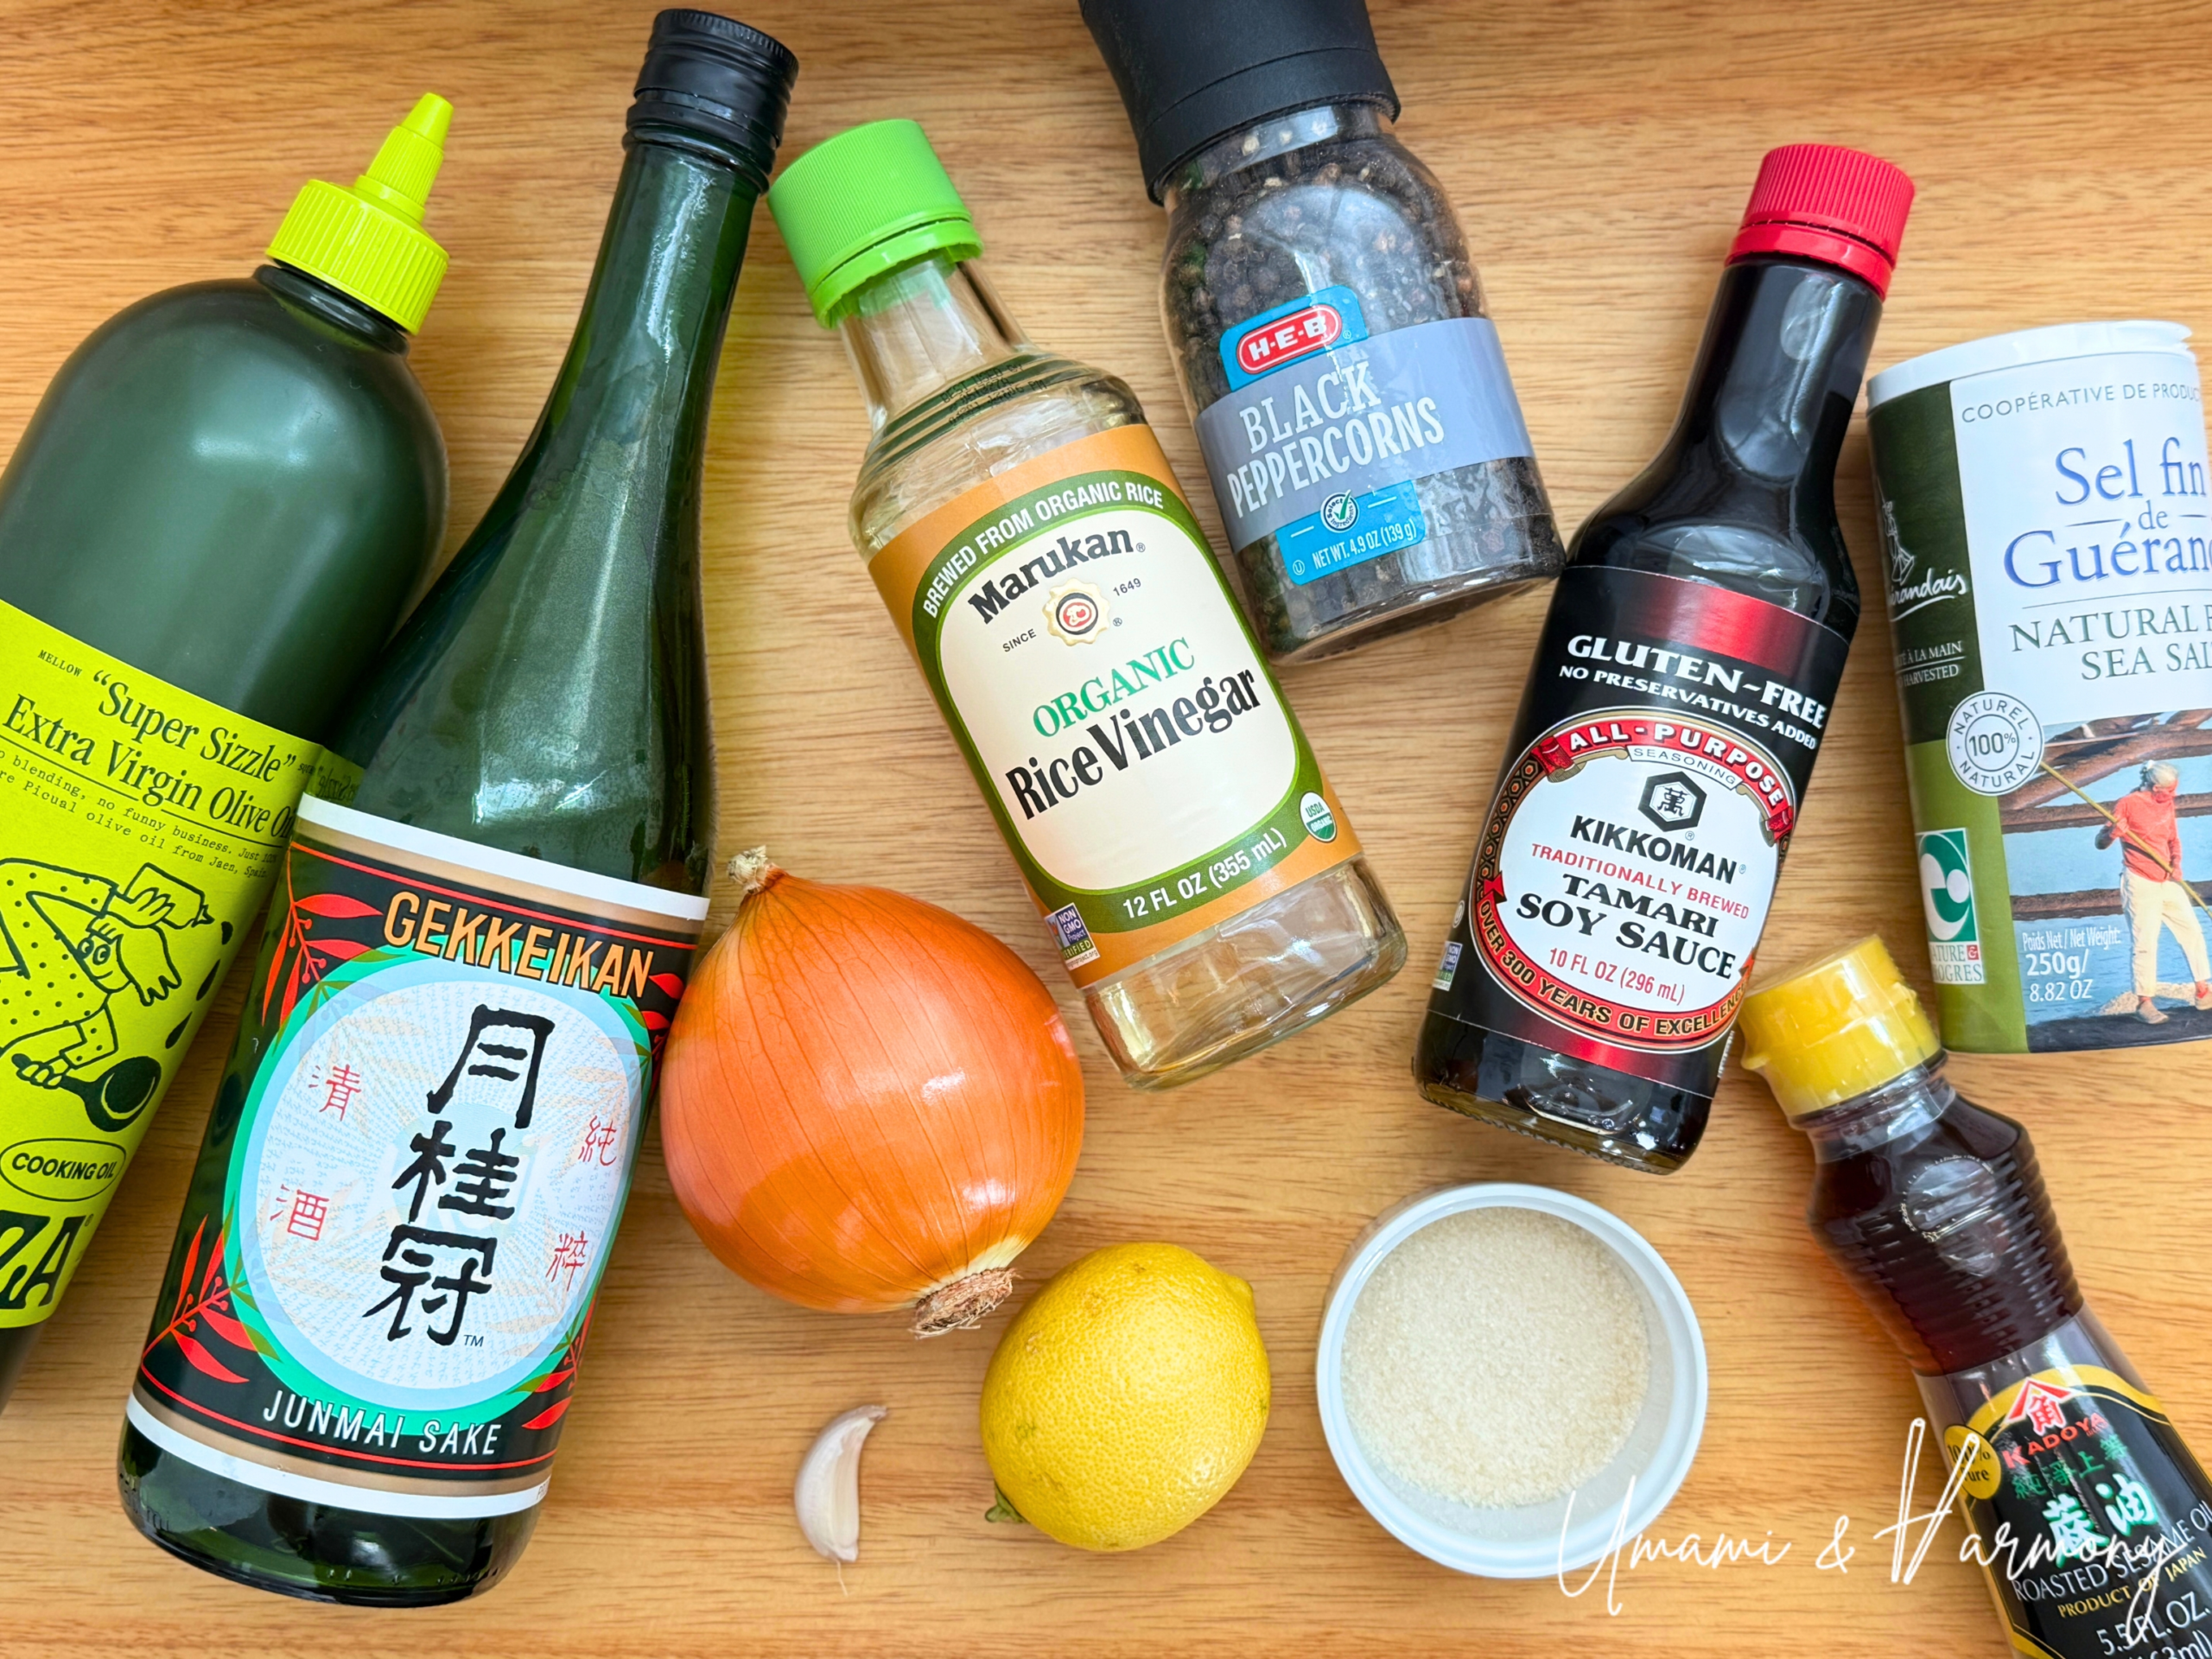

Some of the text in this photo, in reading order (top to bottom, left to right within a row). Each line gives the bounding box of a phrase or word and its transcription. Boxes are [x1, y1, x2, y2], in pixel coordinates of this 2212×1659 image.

[1247, 314, 1327, 362] H-E-B
[1239, 360, 1382, 454] BLACK
[1961, 385, 2114, 423] COOPÉRATIVE
[2123, 384, 2146, 399] DE
[1227, 396, 1445, 518] PEPPERCORNS
[2055, 436, 2207, 506] Sel fin
[2138, 499, 2169, 531] de
[923, 481, 1165, 618] BREWED FROM ORGANIC RICE
[1312, 518, 1417, 570] NET WT. 4.9 OZ (139 g)
[967, 528, 1135, 625] Marukan
[1113, 577, 1142, 597] 1649
[1002, 628, 1037, 653] SINCE
[1914, 648, 1927, 663] LA
[1929, 640, 1962, 659] MAIN
[2008, 604, 2199, 652] NATURAL
[37, 649, 83, 677] MELLOW
[1567, 634, 1827, 730] GLUTEN-FREE
[1904, 664, 1960, 687] HARVESTED
[2081, 641, 2212, 681] SEA SAL
[1033, 637, 1196, 738] ORGANIC
[1559, 664, 1818, 751] NO PRESERVATIVES ADDED
[1954, 698, 2026, 735] NATUREL
[3, 693, 96, 766] Extra
[107, 740, 204, 811] Virgin
[209, 787, 270, 833] Olive
[1005, 668, 1262, 821] Rice Vinegar
[1568, 722, 1783, 807] ALL-PURPOSE
[1633, 747, 1737, 787] SEASONING
[1959, 750, 2036, 789] NATURAL
[1968, 732, 2017, 757] 100%
[13, 755, 86, 800] blending,
[97, 798, 116, 810] no
[124, 808, 166, 831] funny
[172, 826, 232, 854] business.
[238, 848, 260, 861] Just
[22, 780, 77, 813] Picual
[86, 812, 131, 836] olive
[140, 834, 166, 849] oil
[173, 844, 204, 863] from
[209, 856, 238, 874] Jaen,
[1305, 801, 1325, 817] USDA
[1122, 826, 1287, 918] 12 FL OZ (355 mL)
[1569, 815, 1738, 885] KIKKOMAN
[1530, 842, 1750, 919] TRADITIONALLY BREWED
[1562, 873, 1719, 938] TAMARI
[1058, 908, 1077, 925] NON
[1063, 918, 1082, 934] GMO
[1516, 892, 1737, 980] SOY SAUCE
[2022, 931, 2046, 951] Poids
[2045, 931, 2063, 950] Net
[2069, 928, 2086, 948] Net
[2086, 925, 2121, 950] Weight:
[383, 890, 654, 999] GEKKEIKAN
[1478, 899, 1506, 955] OVER
[1502, 949, 1537, 986] 300
[1538, 978, 1612, 1025] YEARS
[1618, 1012, 1650, 1033] OF
[1931, 944, 1978, 962] ATURE &
[2024, 948, 2089, 980] 250g/
[1548, 947, 1686, 1006] 10 FL OZ (296 mL)
[1933, 963, 1983, 982] OGRES
[2029, 978, 2094, 1002] 8.82 OZ
[11, 1152, 118, 1180] COOKING OIL
[463, 1334, 484, 1348] TM
[263, 1389, 502, 1455] JUNMAI SAKE
[2001, 1412, 2108, 1468] KADOYA
[2012, 1563, 2108, 1603] ROASTED
[2112, 1519, 2196, 1580] SESAME
[2057, 1586, 2132, 1618] PRODUCT
[2164, 1546, 2207, 1583] JAPAN
[2133, 1613, 2173, 1643] FL.
[2165, 1591, 2211, 1629] OZ.
